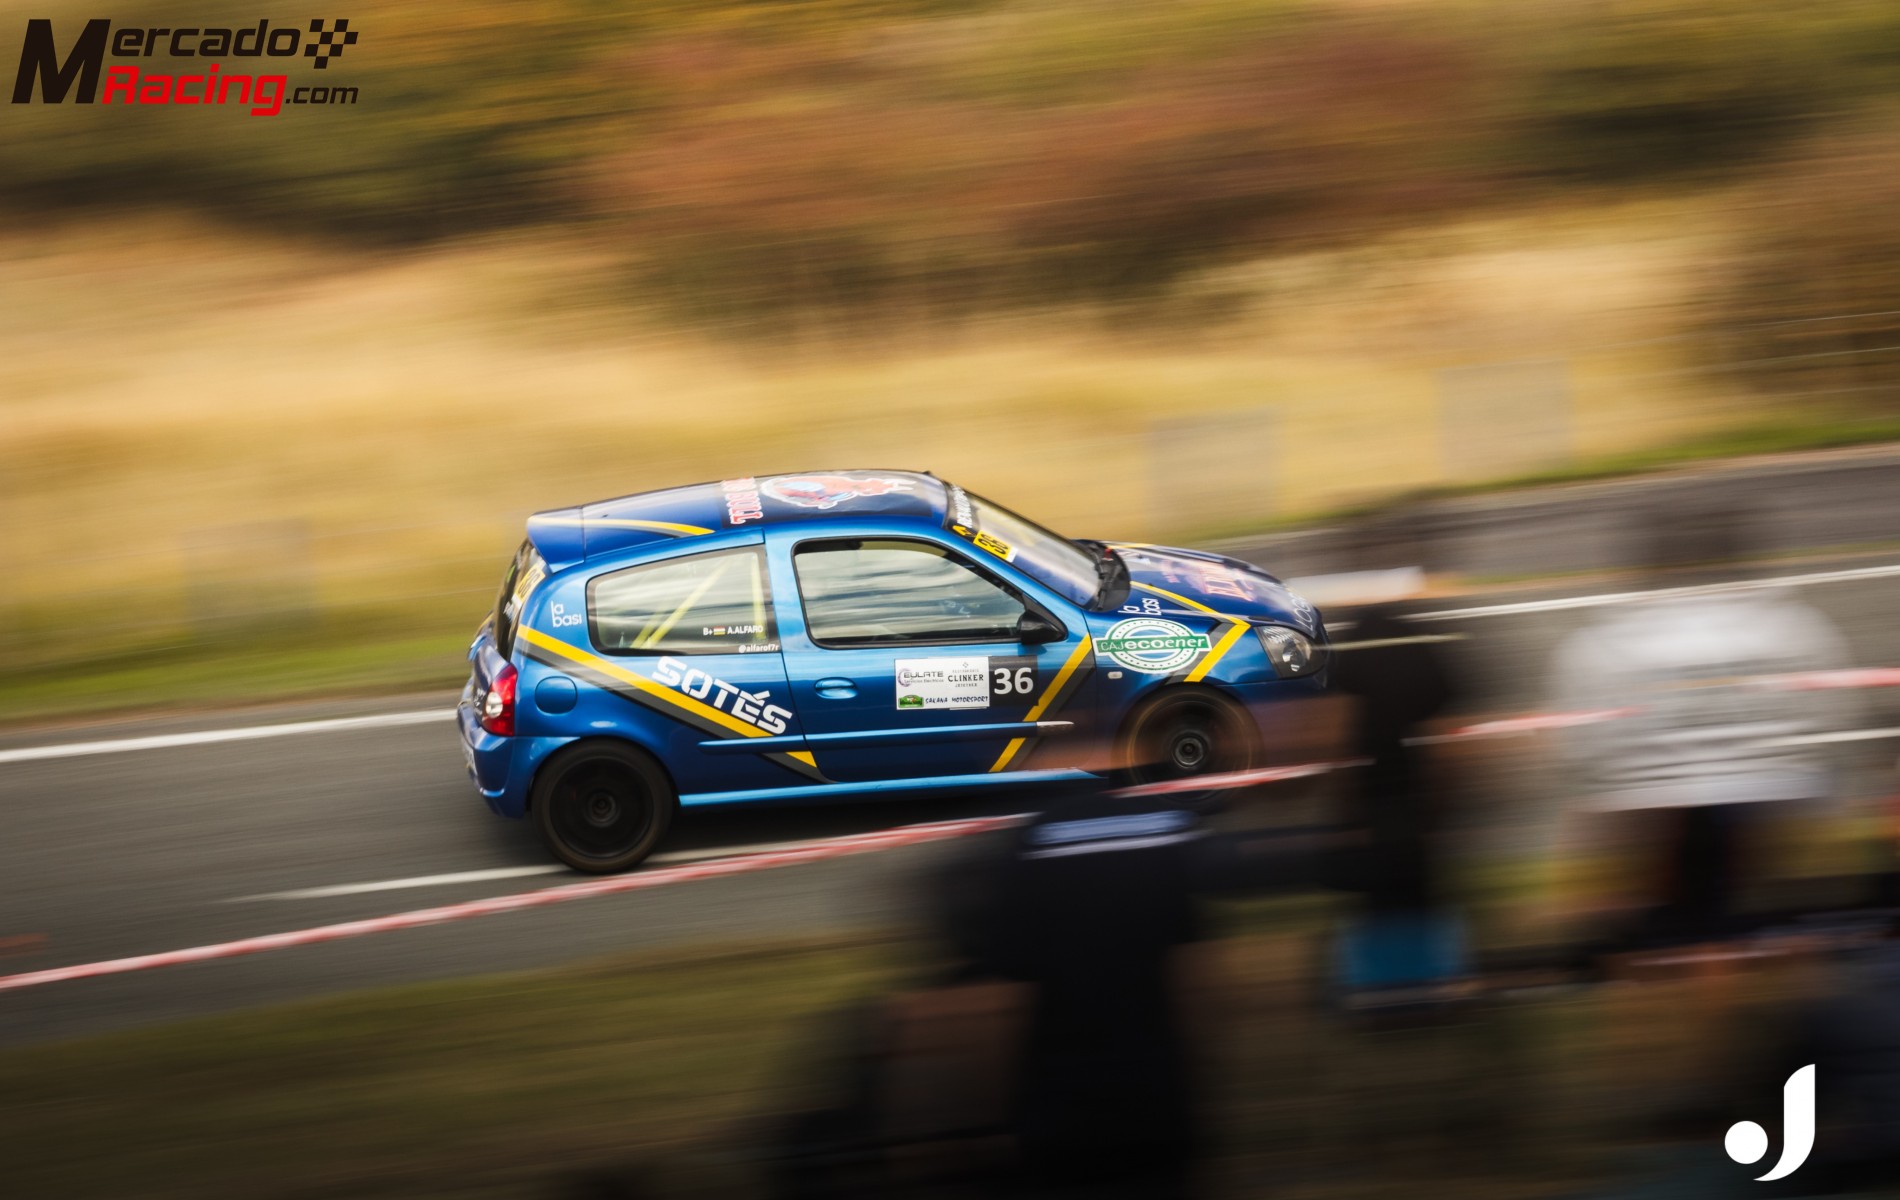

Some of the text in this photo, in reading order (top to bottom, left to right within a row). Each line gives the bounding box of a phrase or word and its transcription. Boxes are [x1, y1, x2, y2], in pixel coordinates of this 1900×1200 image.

[947, 674, 984, 682] CLINKER
[993, 667, 1034, 695] 36
[652, 656, 793, 735] SOTÉS
